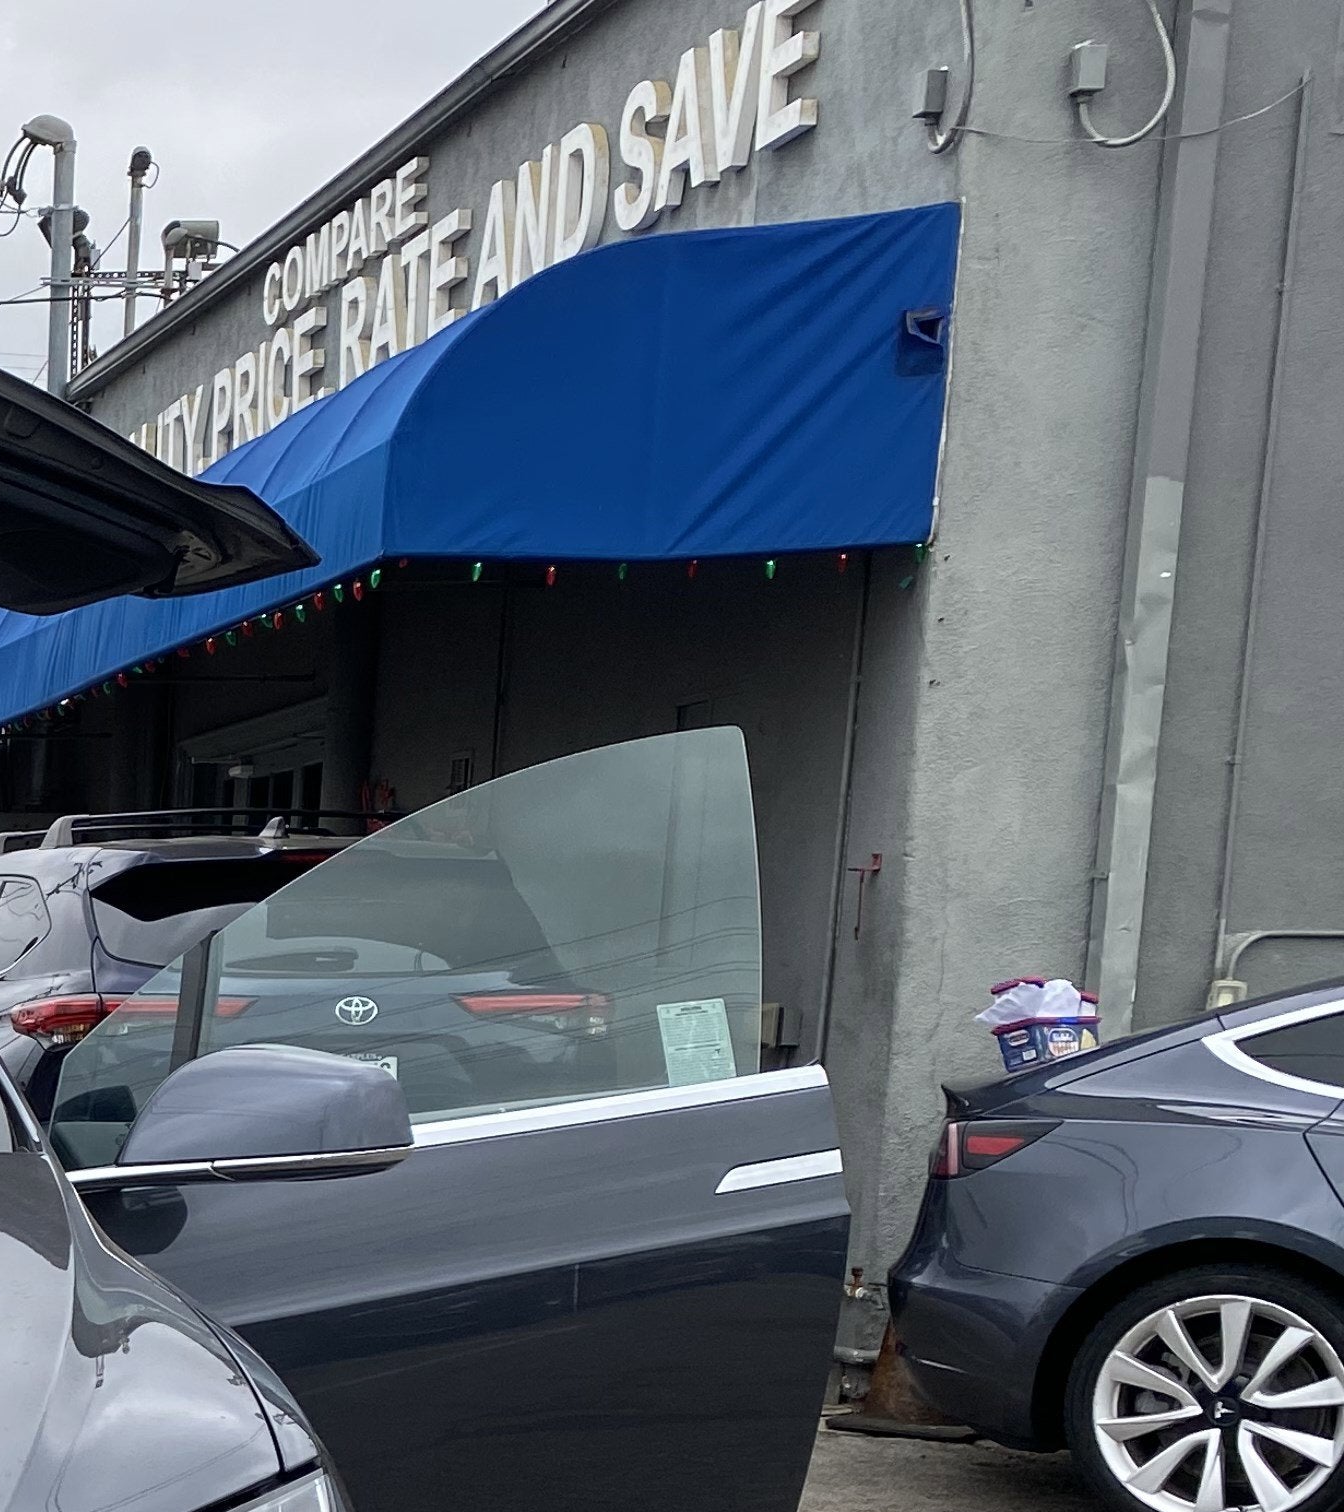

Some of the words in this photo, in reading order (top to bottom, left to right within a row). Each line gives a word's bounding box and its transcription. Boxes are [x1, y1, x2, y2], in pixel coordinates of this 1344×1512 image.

[263, 156, 429, 326] COMPARE
[339, 208, 472, 391] RATE
[471, 122, 610, 311] AND
[614, 0, 821, 231] SAVE
